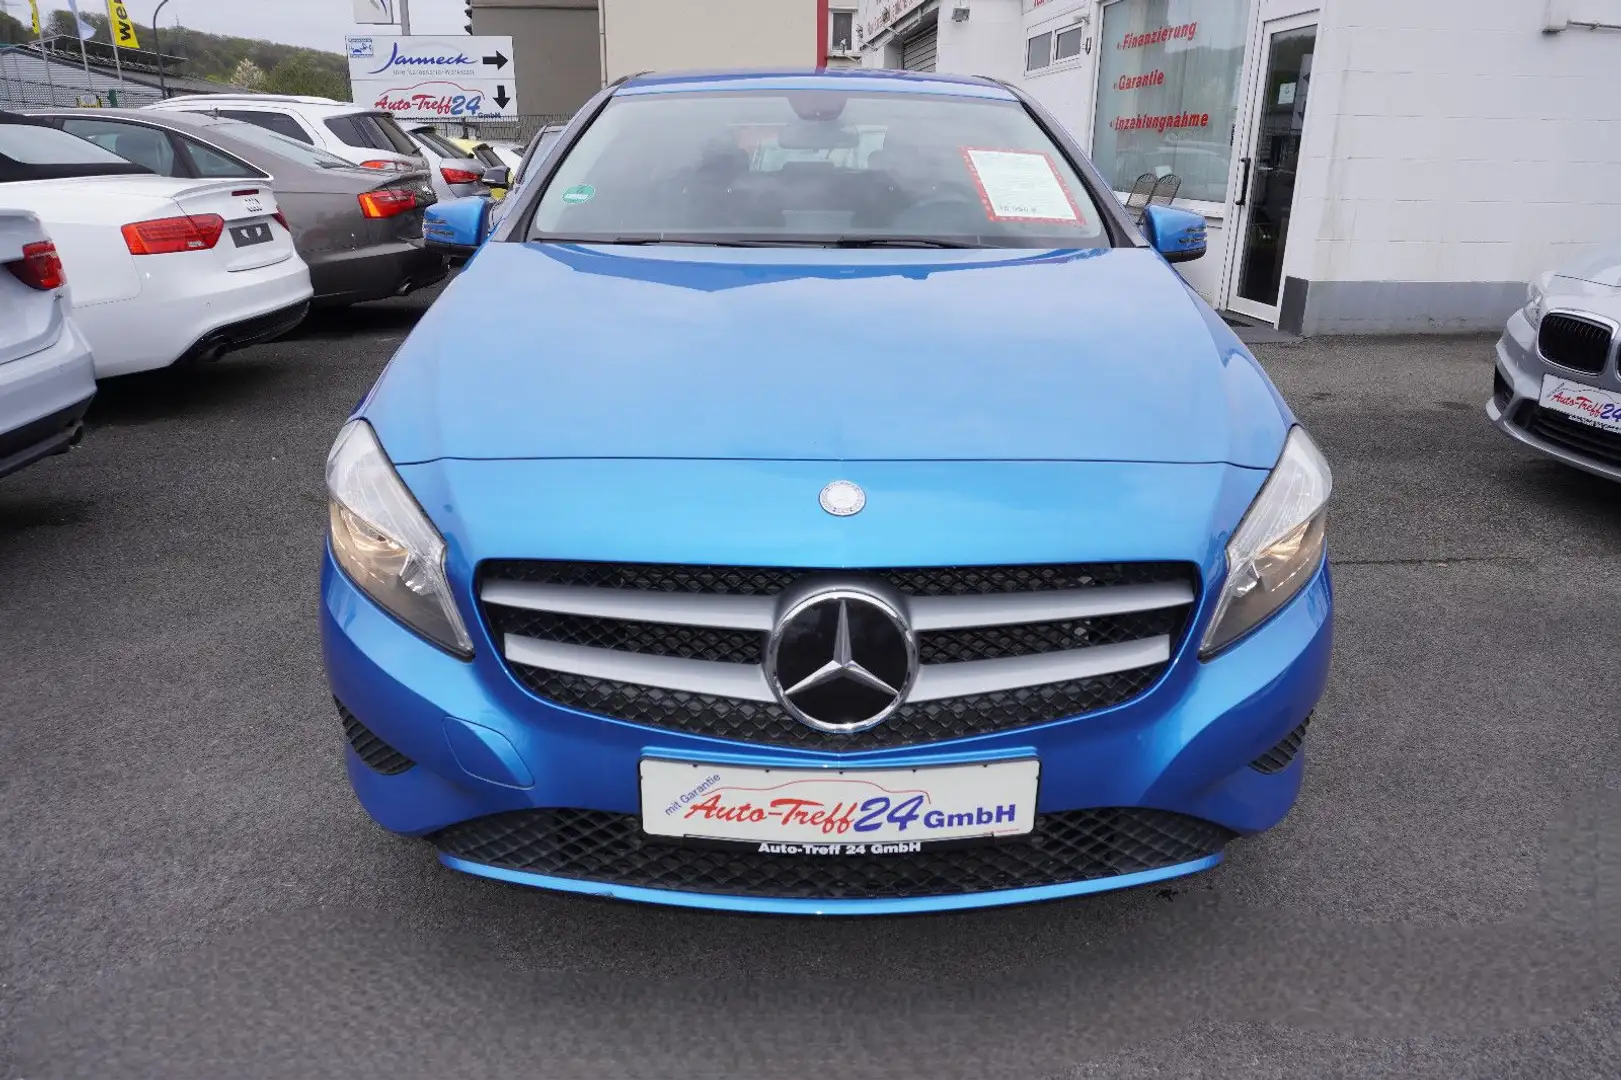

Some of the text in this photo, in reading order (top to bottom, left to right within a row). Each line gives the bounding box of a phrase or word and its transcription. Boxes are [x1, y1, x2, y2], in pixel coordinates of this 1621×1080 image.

[114, 0, 131, 41] we
[1123, 22, 1197, 50] Finanzierung
[1118, 69, 1164, 91] Garantie
[1115, 110, 1209, 133] Inzahlungnahme
[664, 774, 721, 816] mit Garantie
[924, 804, 1016, 829] GmbH
[758, 841, 922, 855] Auto-Treff 24 GmbH
